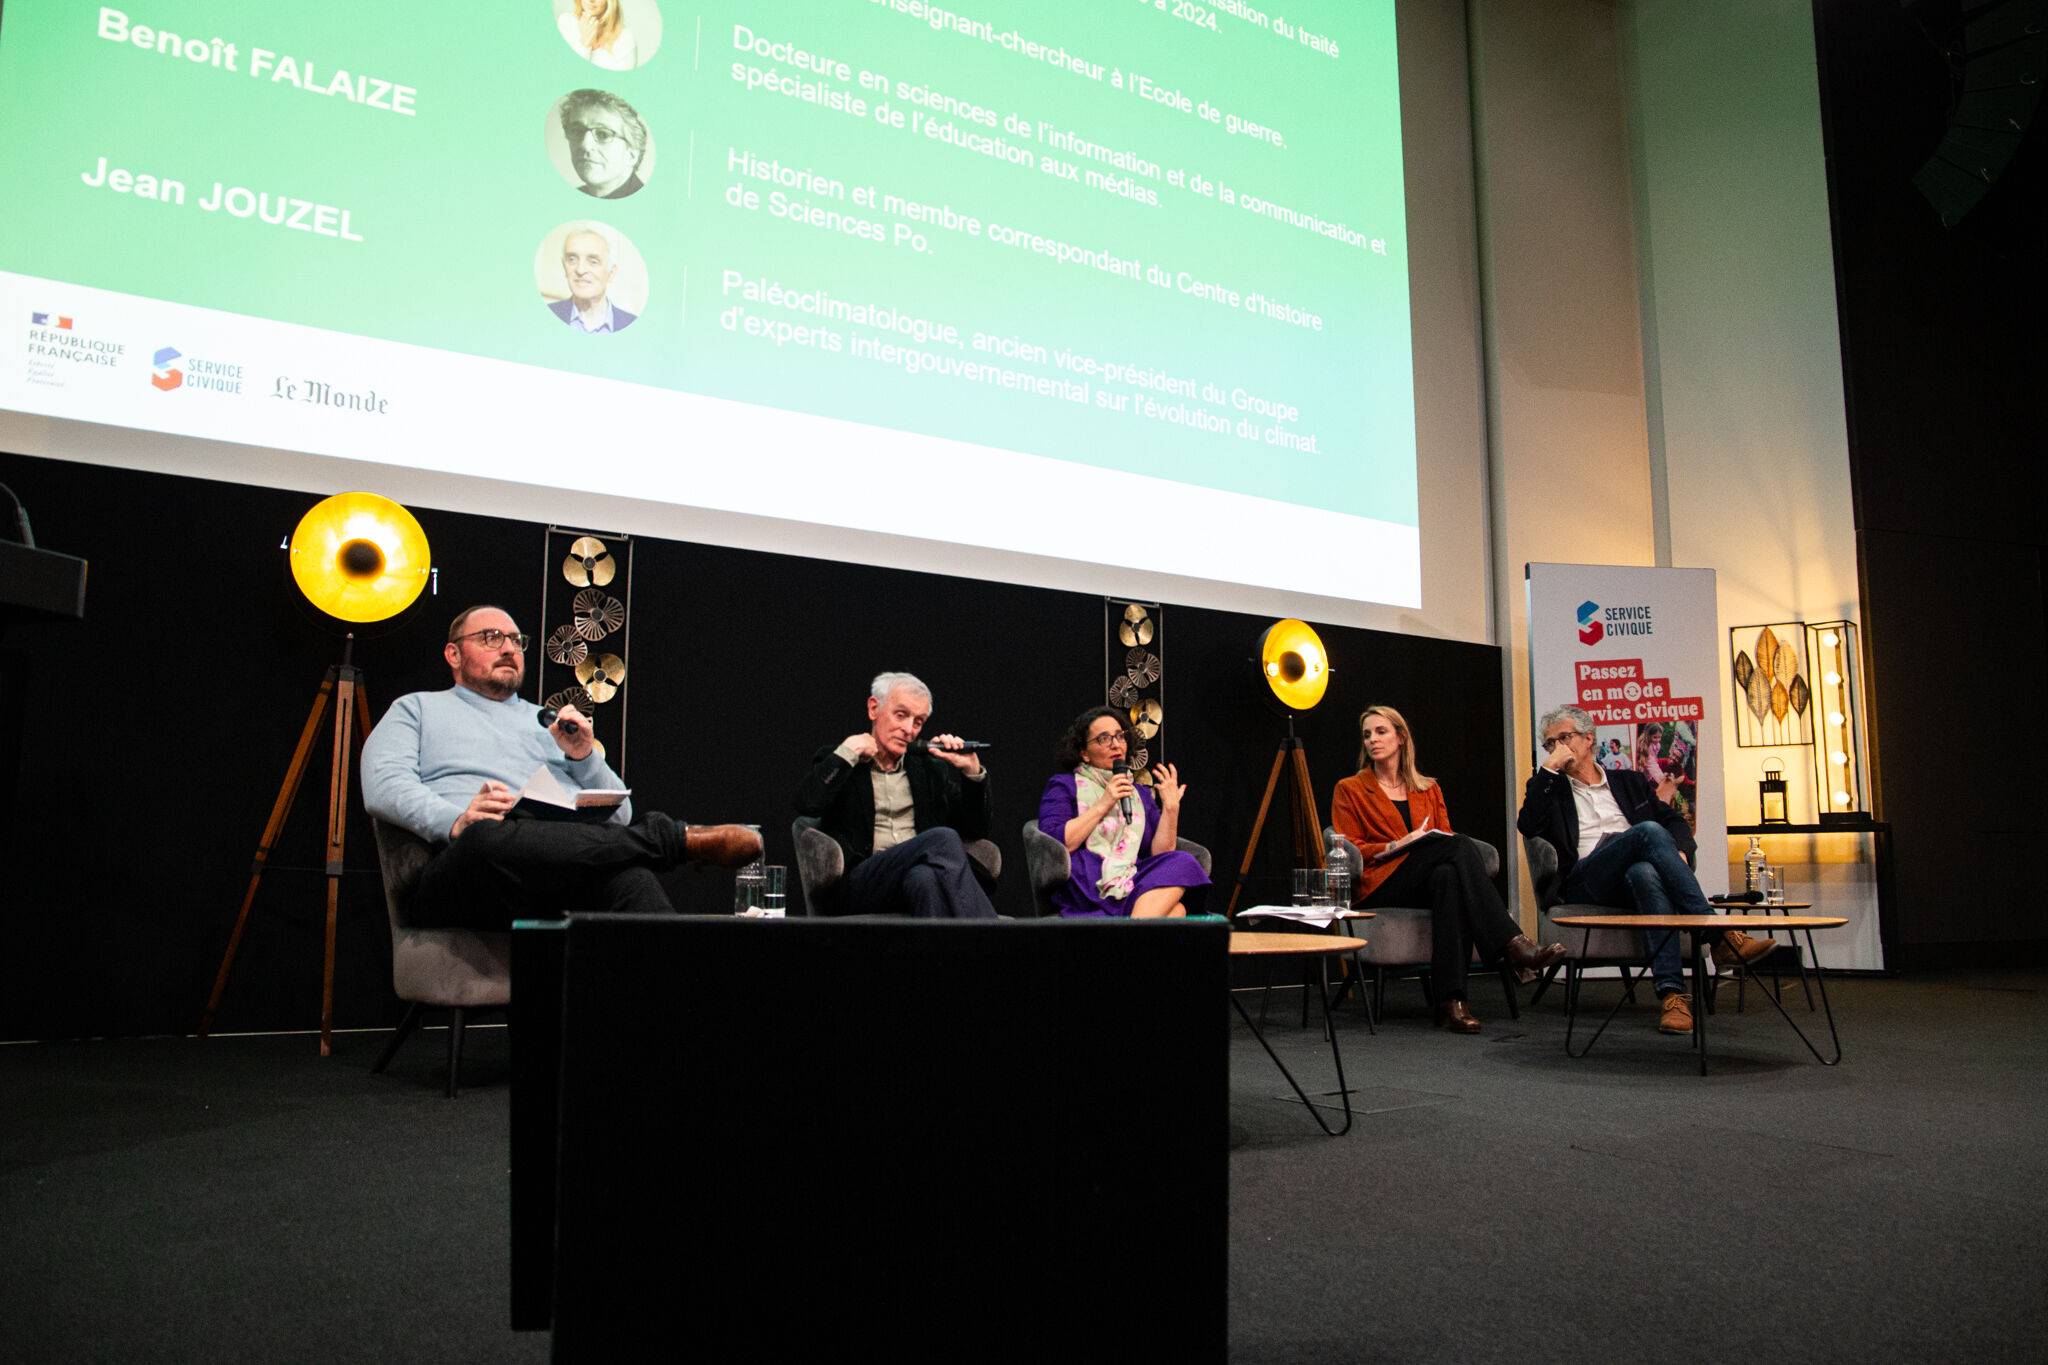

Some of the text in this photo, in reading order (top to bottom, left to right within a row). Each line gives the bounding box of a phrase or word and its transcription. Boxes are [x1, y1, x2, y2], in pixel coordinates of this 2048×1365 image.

[1171, 0, 1222, 34] 2024.
[1272, 16, 1294, 40] du
[1299, 25, 1340, 59] traité
[97, 7, 418, 117] Benoît FALAIZE
[1110, 68, 1123, 90] à
[1128, 73, 1193, 114] l'Ecole
[1197, 100, 1221, 125] de
[1225, 113, 1288, 150] guerre.
[731, 60, 1163, 209] spécialiste de l'éducation aux médias.
[732, 24, 1387, 256] Docteure en sciences de l'information et de la communication et
[81, 157, 364, 243] Jean JOUZEL
[725, 184, 934, 255] de Sciences Po.
[728, 148, 1323, 332] Historien et membre correspondant du Centre d'histoire
[28, 343, 117, 367] FRANÇAISE
[722, 270, 1299, 424] Paléoclimatologue, ancien vice-président du Groupe
[186, 374, 242, 395] CIVIQUE
[188, 358, 244, 380] SERVICE
[720, 307, 1321, 456] d'experts intergouvernemental sur l'évolution du climat.
[271, 375, 389, 415] Le Monde
[1605, 606, 1652, 621] SERVICE
[1606, 621, 1654, 637] CIVIQUE
[1580, 664, 1637, 680] Passez
[1582, 687, 1604, 701] en
[1588, 701, 1699, 722] rvice Civique
